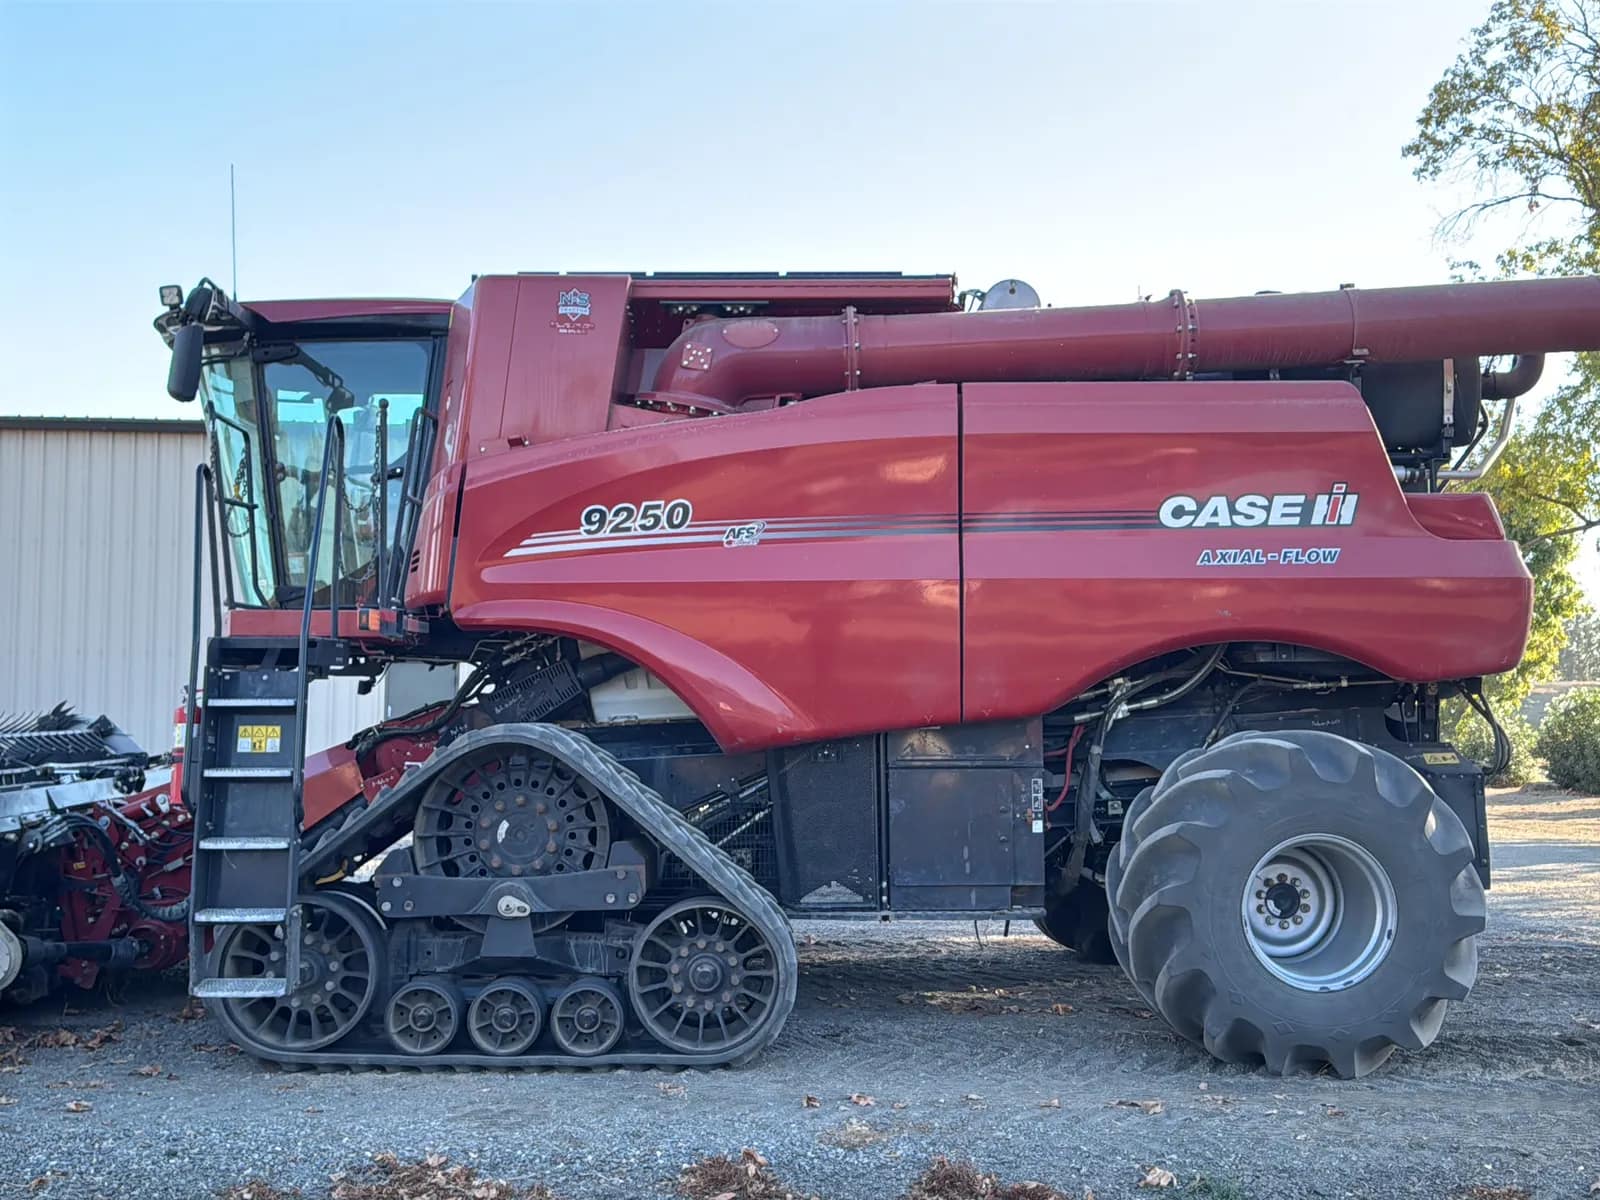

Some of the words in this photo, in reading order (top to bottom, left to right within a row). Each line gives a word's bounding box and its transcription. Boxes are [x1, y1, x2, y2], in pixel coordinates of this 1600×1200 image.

[580, 499, 693, 535] 9250
[1159, 495, 1306, 528] CASE
[724, 525, 757, 541] AFS
[1196, 548, 1341, 566] AXIAL-FLOW
